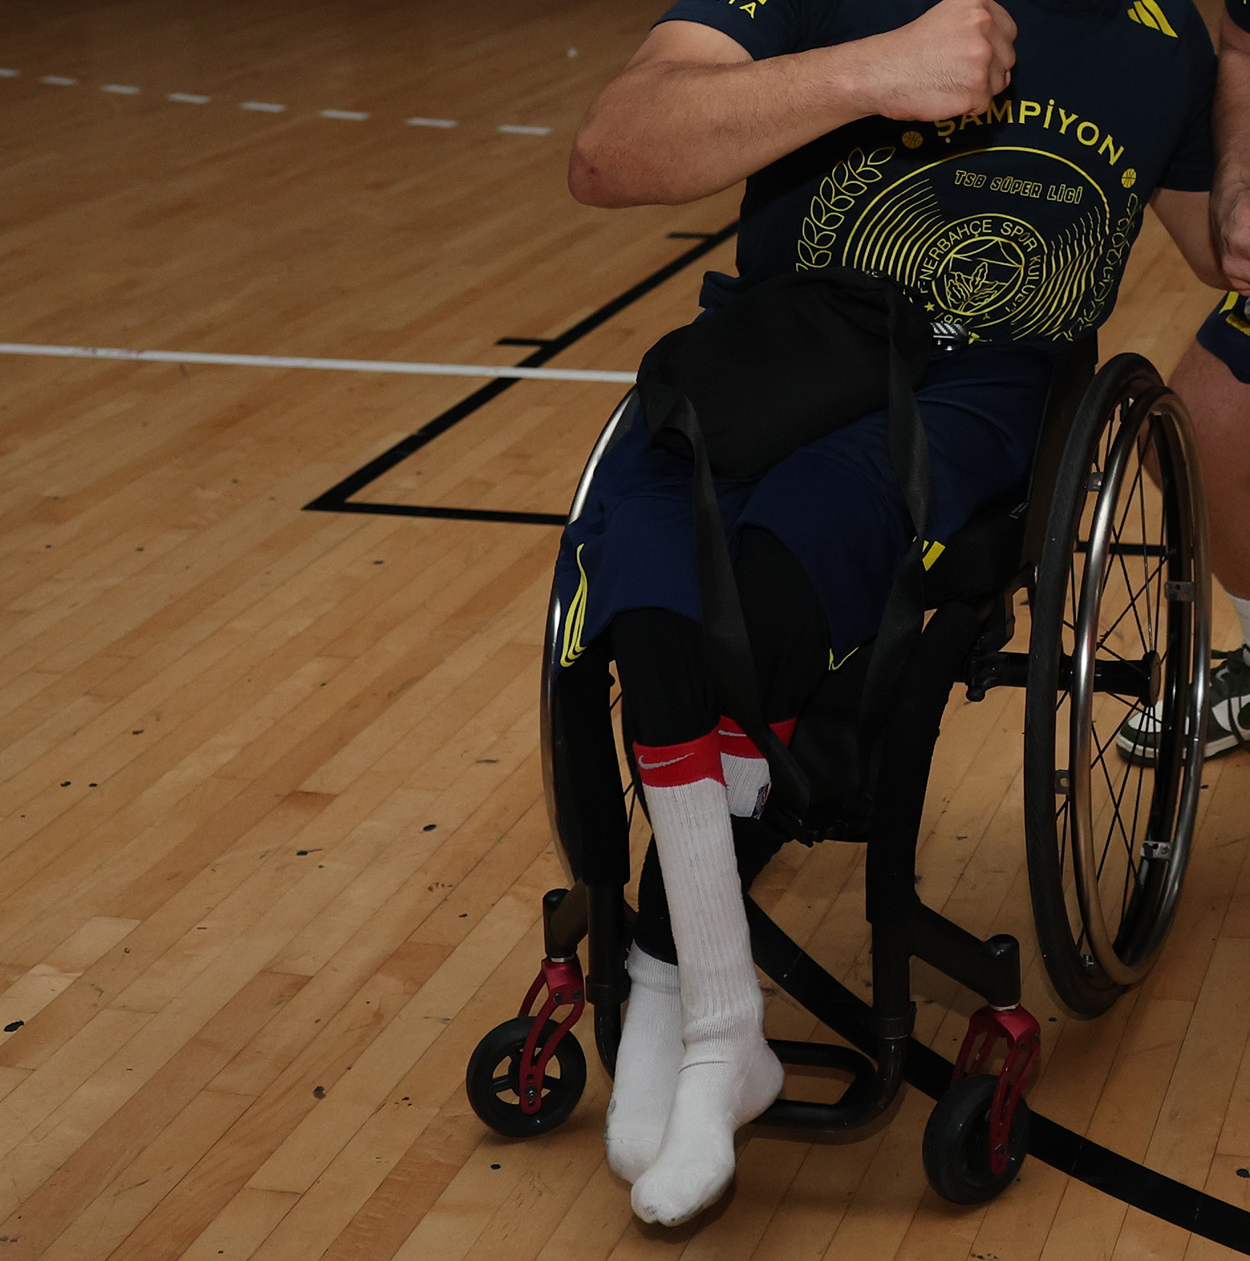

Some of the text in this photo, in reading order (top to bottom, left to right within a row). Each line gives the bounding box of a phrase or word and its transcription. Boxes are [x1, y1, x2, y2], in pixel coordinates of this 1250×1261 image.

[933, 98, 1125, 166] ŞAMPİYON
[954, 169, 988, 189] TSB
[1000, 221, 1038, 252] SPOR
